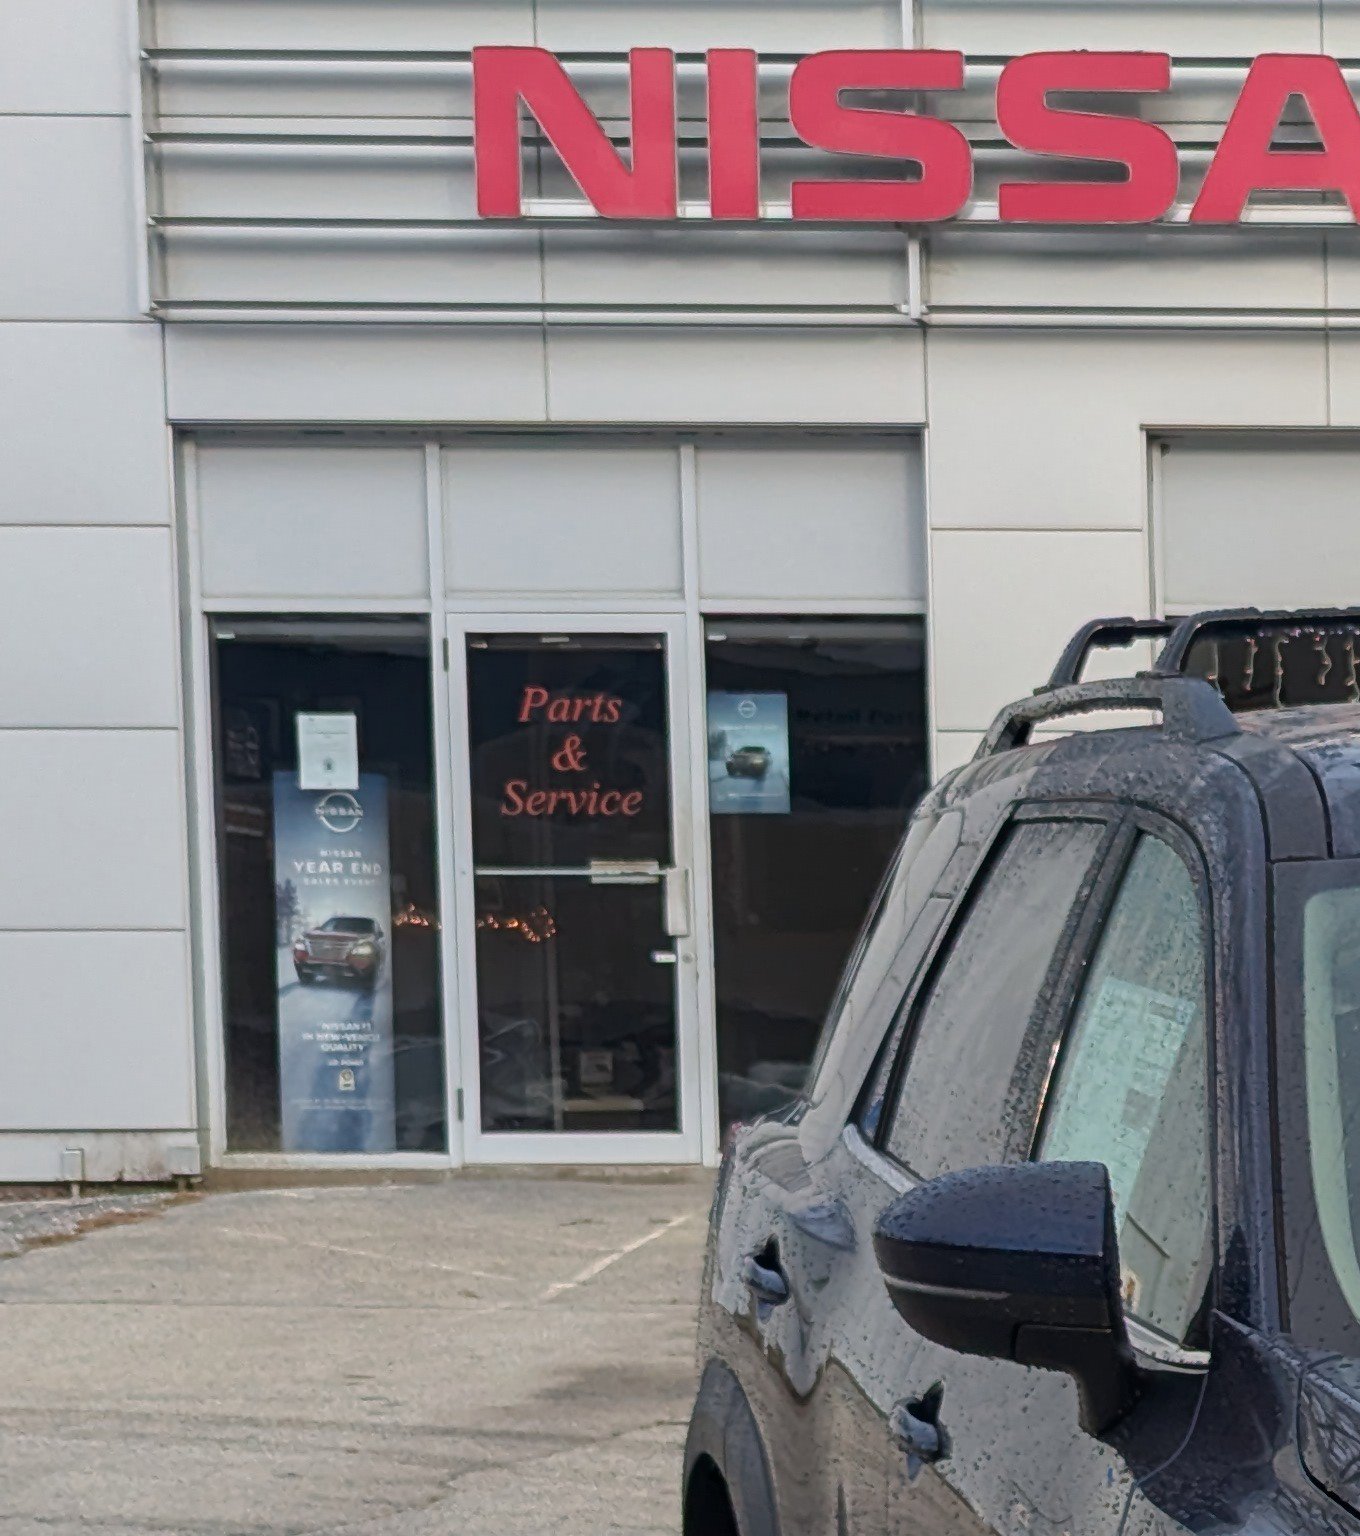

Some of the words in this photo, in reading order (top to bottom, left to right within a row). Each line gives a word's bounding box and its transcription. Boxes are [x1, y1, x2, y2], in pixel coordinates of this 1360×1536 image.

[518, 685, 623, 723] Parts
[552, 734, 587, 771] &
[500, 779, 643, 816] Service
[293, 861, 344, 874] YEAR
[350, 862, 382, 876] END
